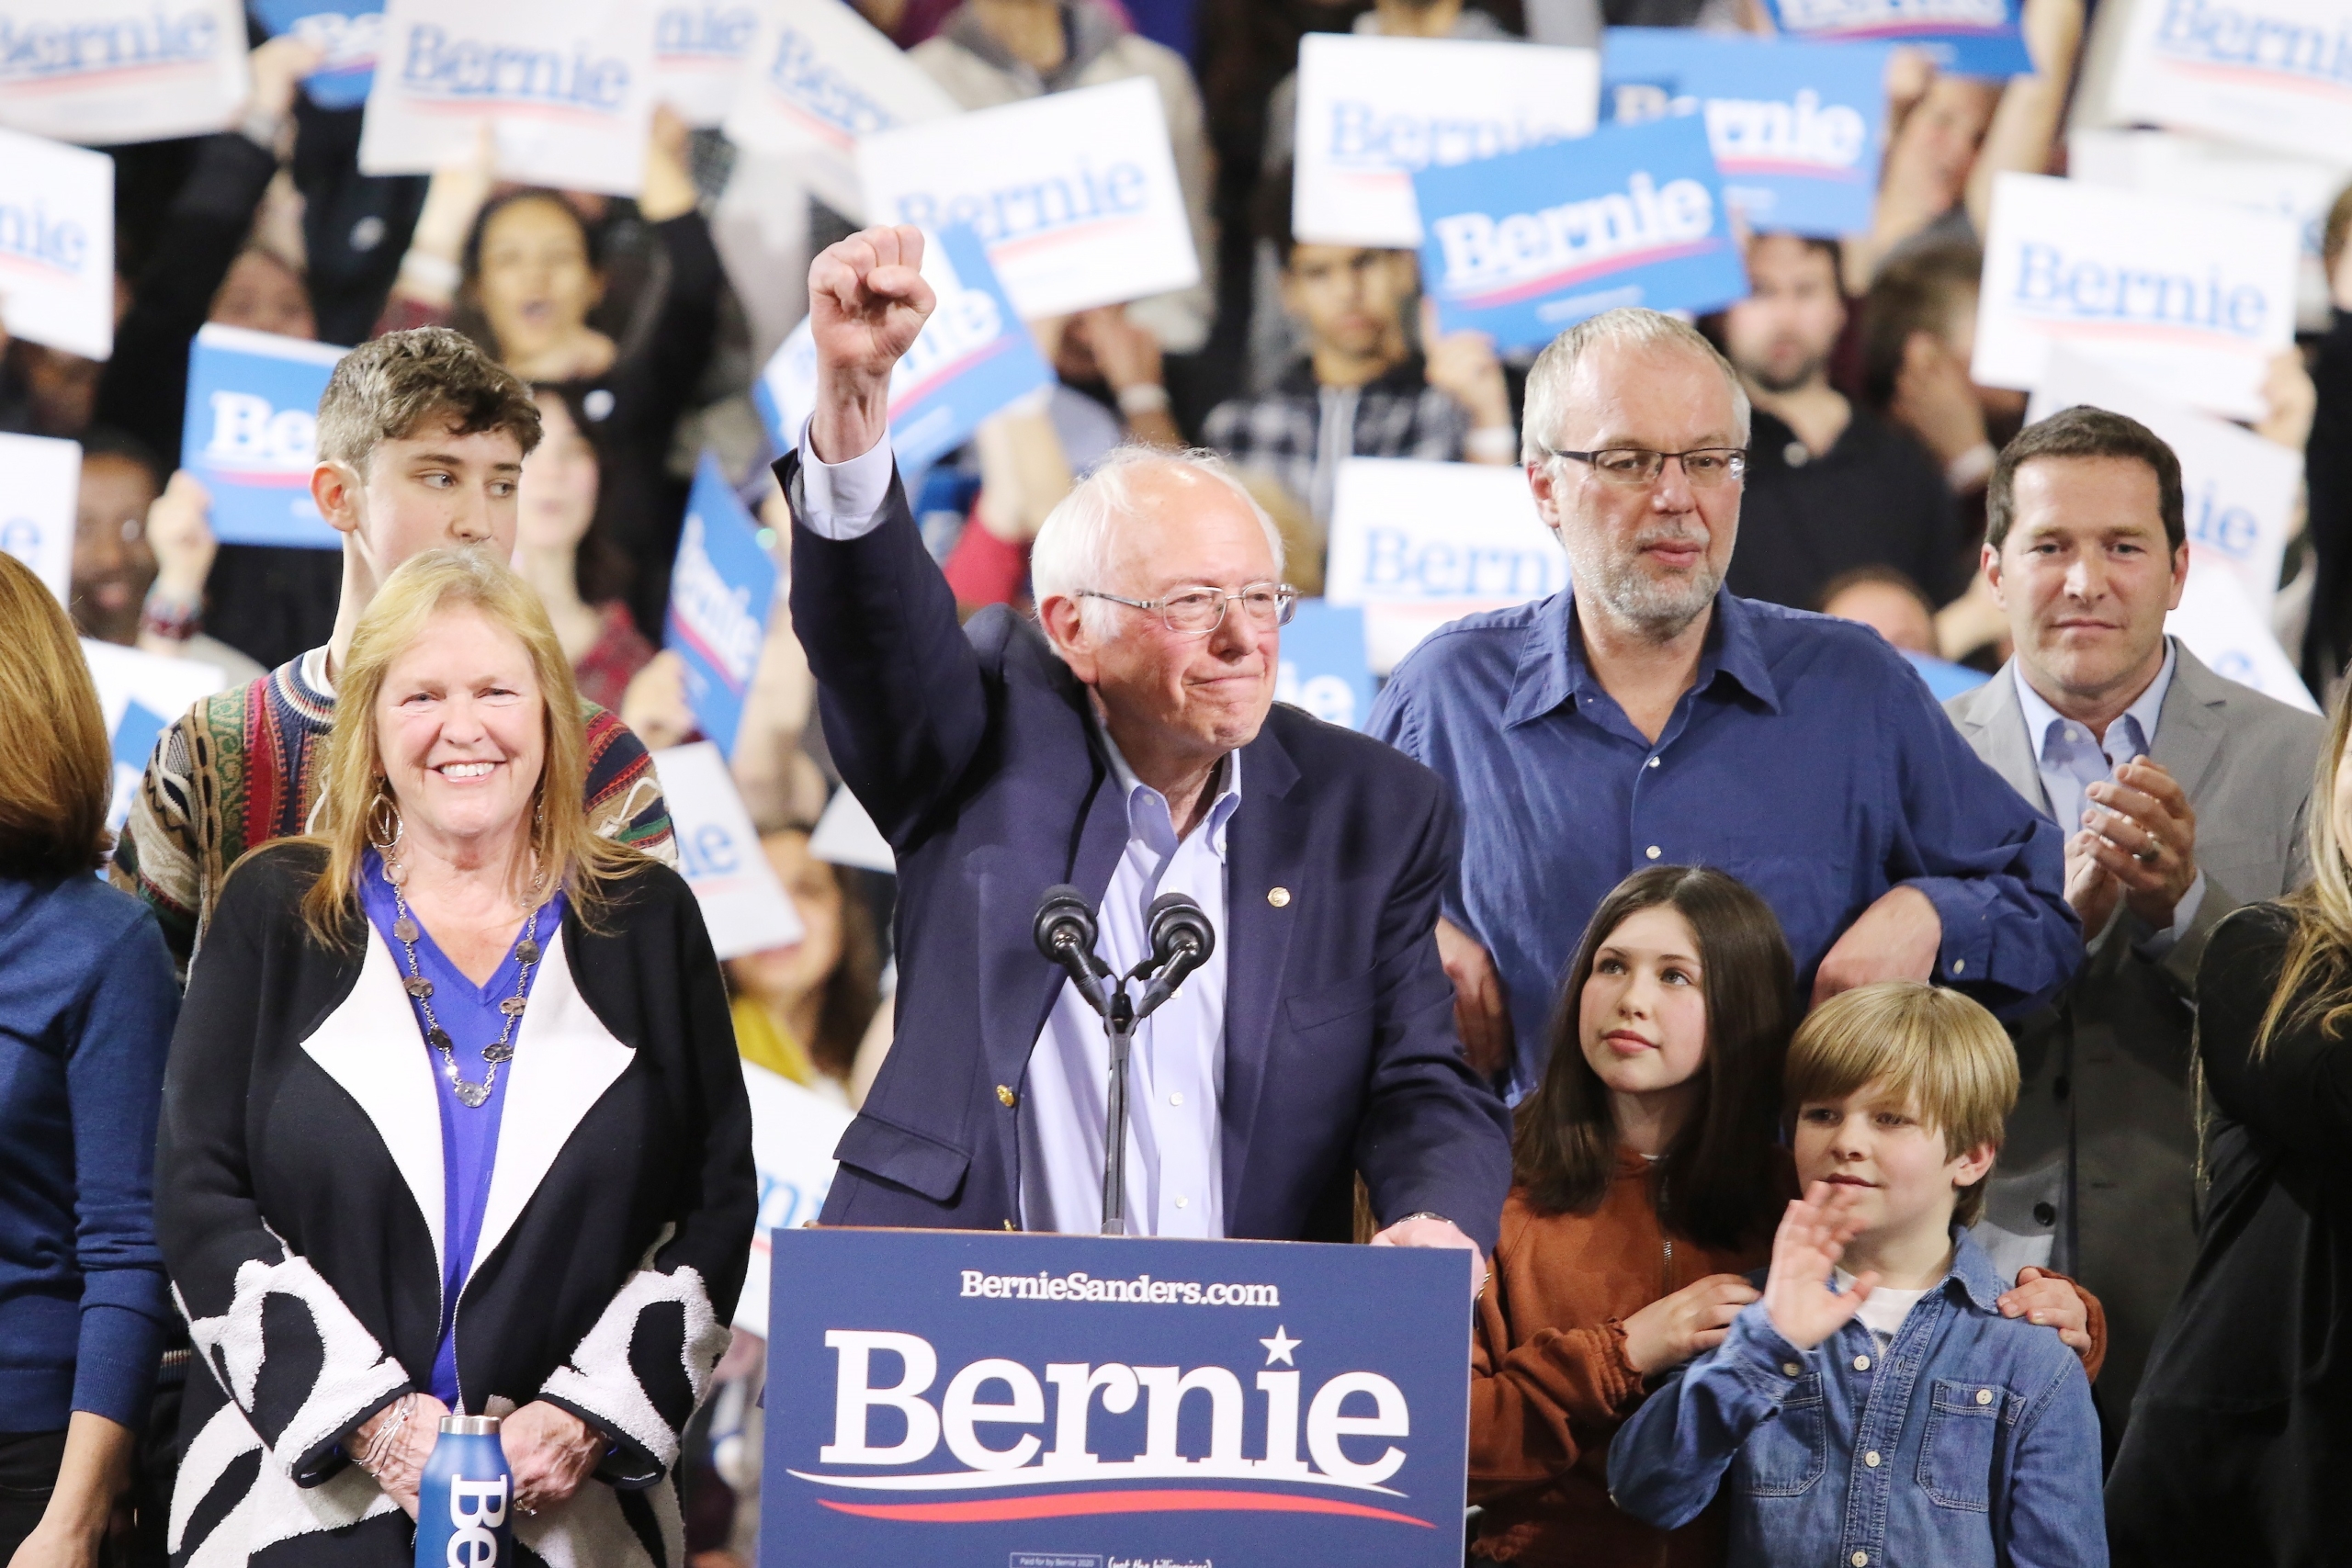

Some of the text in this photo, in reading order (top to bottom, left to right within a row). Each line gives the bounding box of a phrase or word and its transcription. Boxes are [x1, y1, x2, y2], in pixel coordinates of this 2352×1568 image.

[401, 20, 634, 112] Bernie
[1438, 171, 1714, 292] Bernie
[2012, 239, 2268, 338] Bernie
[1363, 525, 1554, 599] Bern
[959, 1269, 1281, 1308] BernieSanders.com
[820, 1323, 1411, 1485] Bernie
[447, 1473, 508, 1568] Be
